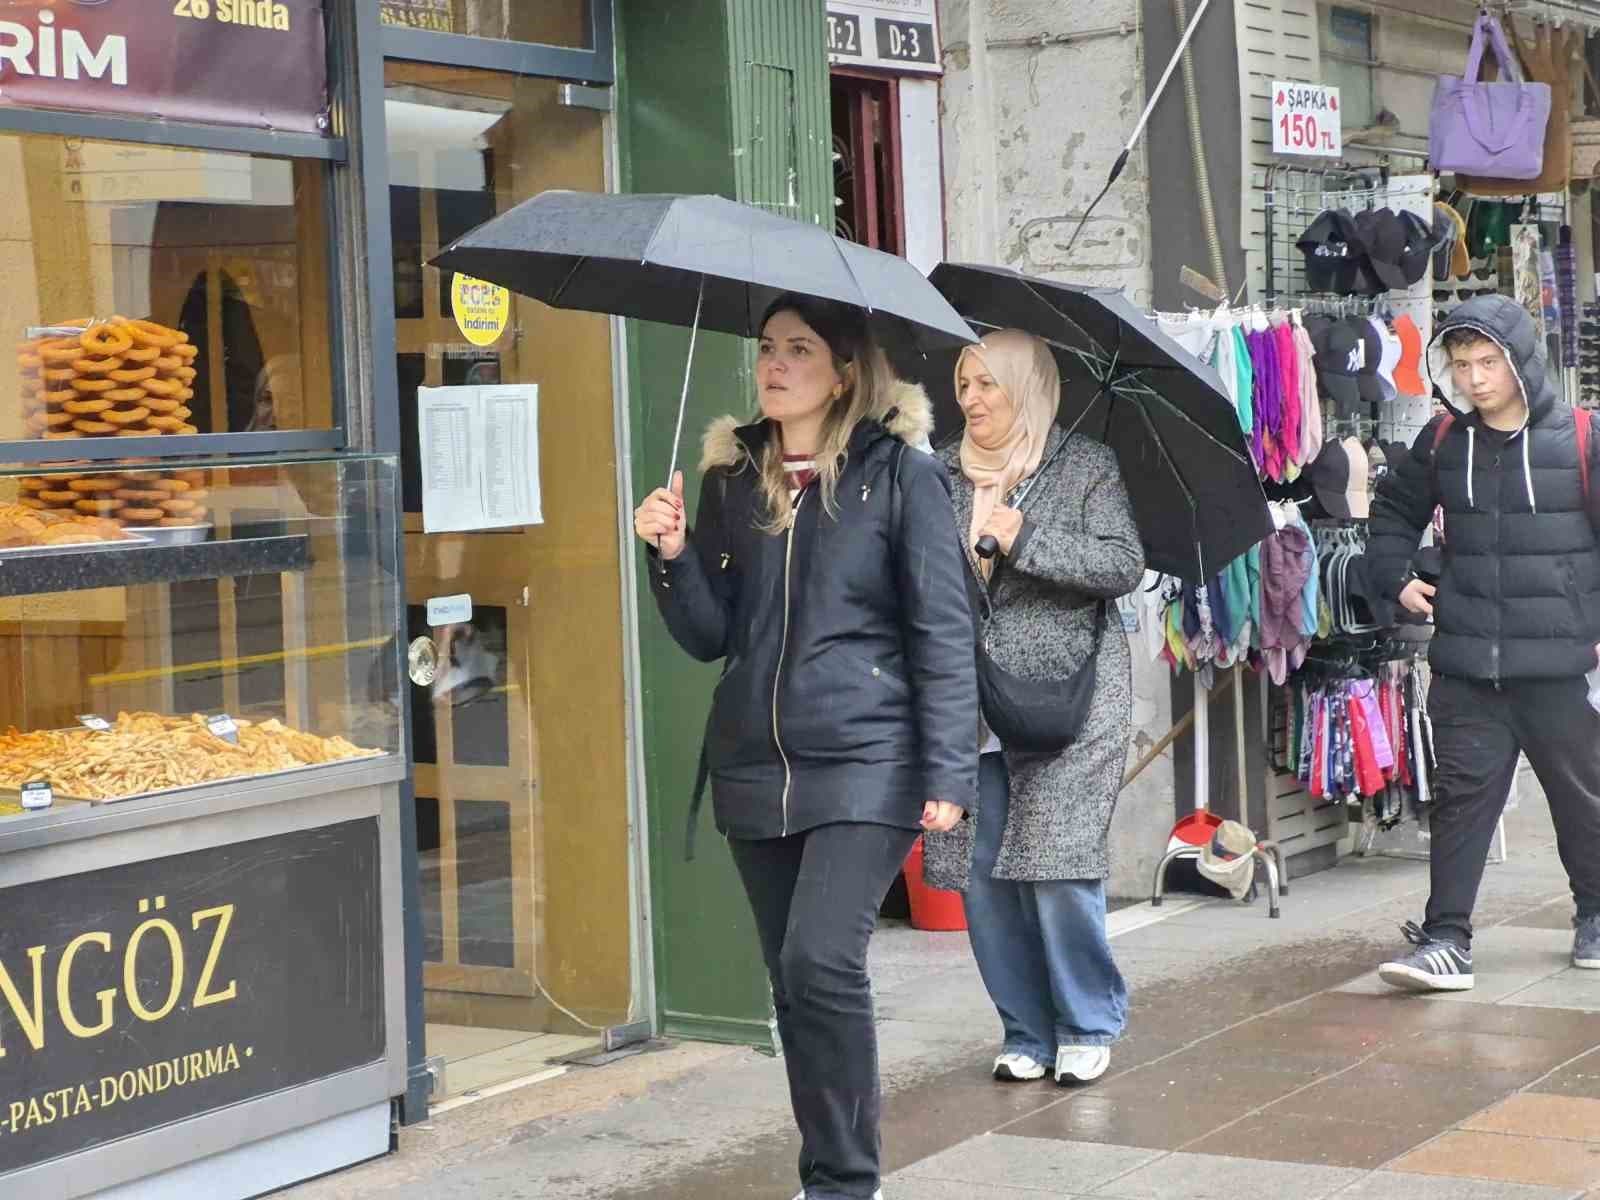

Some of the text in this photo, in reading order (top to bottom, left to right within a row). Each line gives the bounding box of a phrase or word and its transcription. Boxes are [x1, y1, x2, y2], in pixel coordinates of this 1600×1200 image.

[0, 9, 128, 86] RİM
[827, 17, 857, 51] T:2
[889, 24, 920, 57] D:3
[1288, 88, 1328, 112] ŞAPKA
[1280, 113, 1335, 149] 150 TL
[0, 895, 238, 1057] NGÖZ
[0, 1042, 241, 1136] -PASTA-DONDURMA
